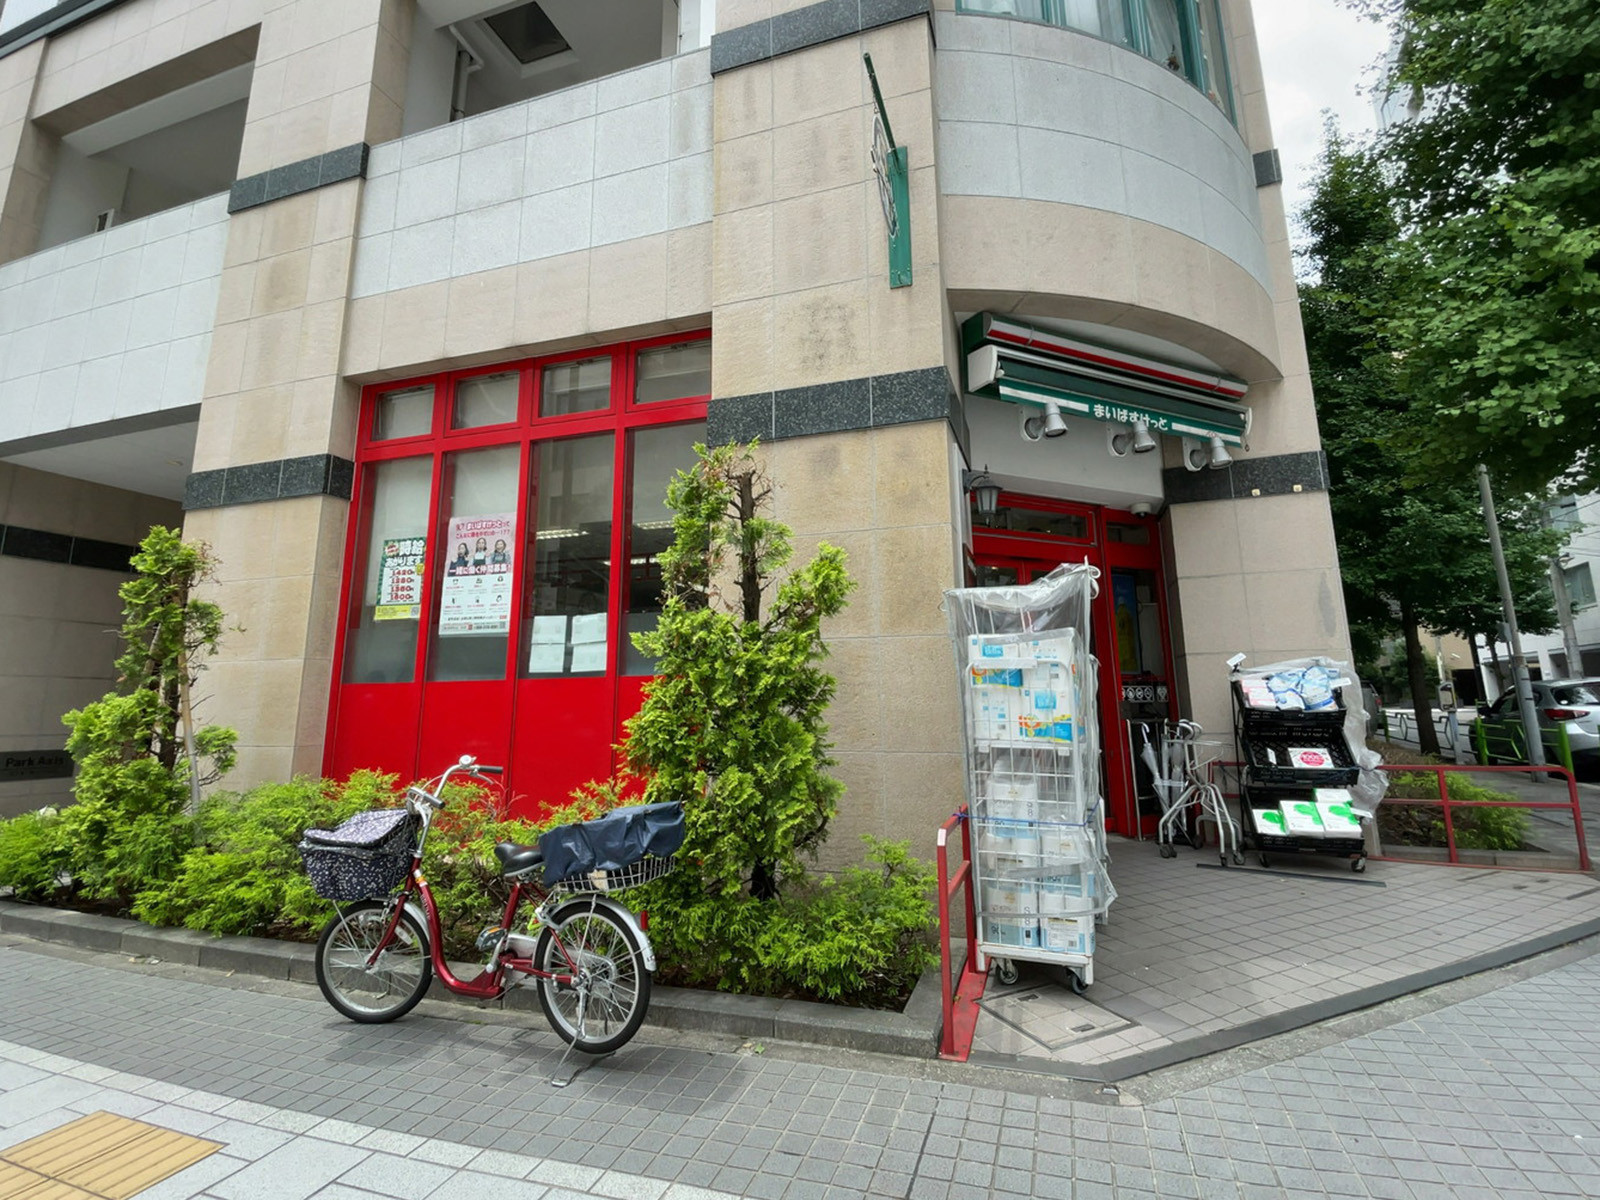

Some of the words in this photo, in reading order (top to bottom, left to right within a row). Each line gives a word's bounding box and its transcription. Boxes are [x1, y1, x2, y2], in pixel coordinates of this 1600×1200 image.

[1093, 403, 1168, 431] まいばすけっと
[400, 540, 425, 556] 時給
[5, 757, 34, 767] Park
